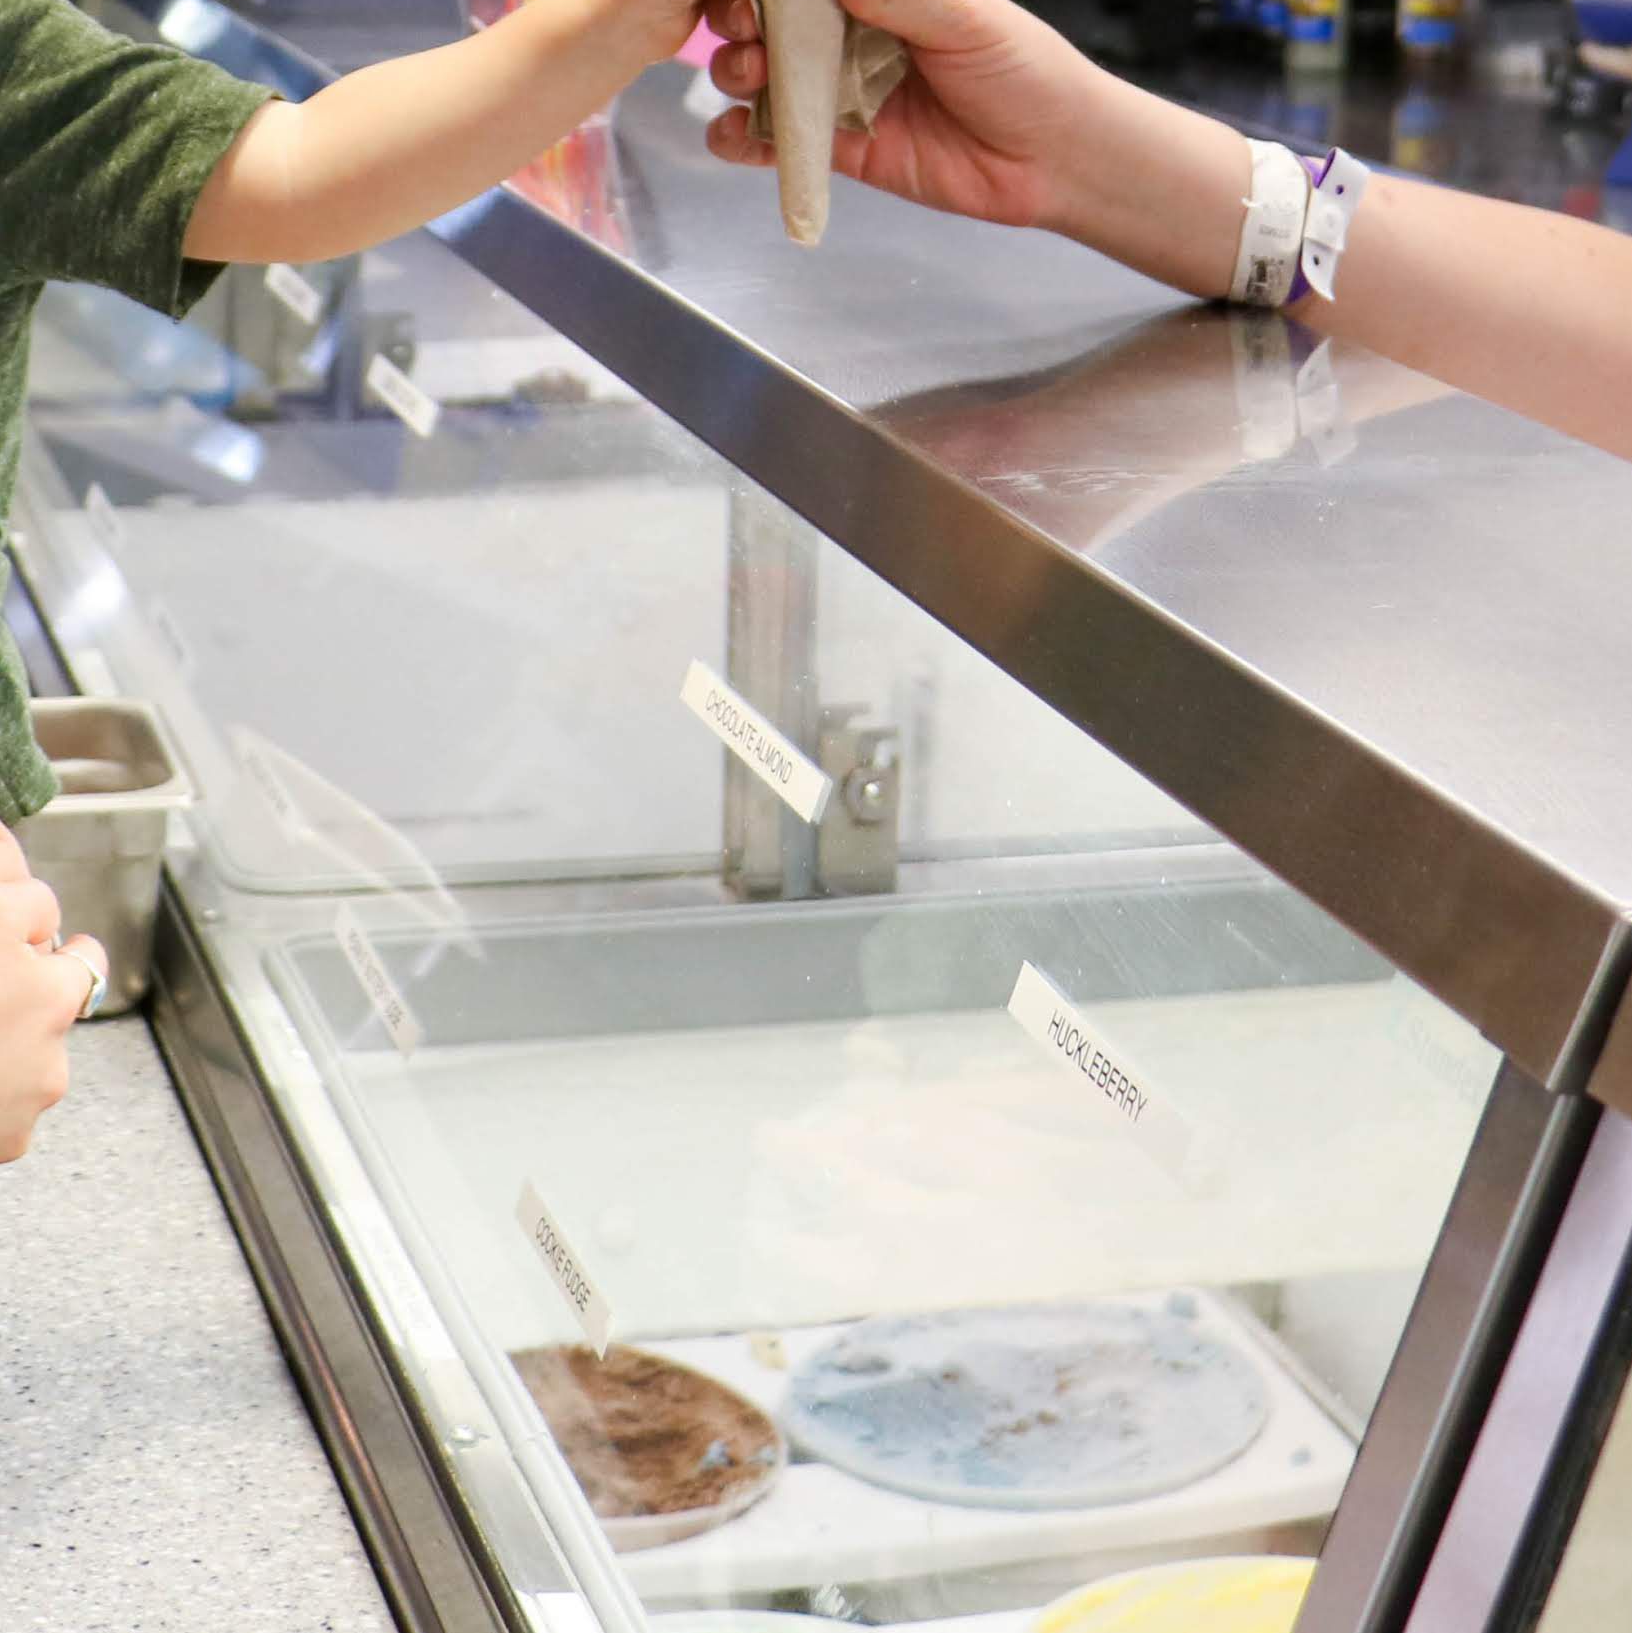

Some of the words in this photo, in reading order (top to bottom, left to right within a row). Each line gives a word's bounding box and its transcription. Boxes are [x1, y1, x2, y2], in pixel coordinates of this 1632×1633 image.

[705, 689, 758, 751] CHOCOLATE
[752, 734, 794, 786] ALMOND
[1047, 1009, 1148, 1123] HUCKLEBERRY
[535, 1216, 567, 1272] COOKIE
[561, 1258, 592, 1313] FUDGE
